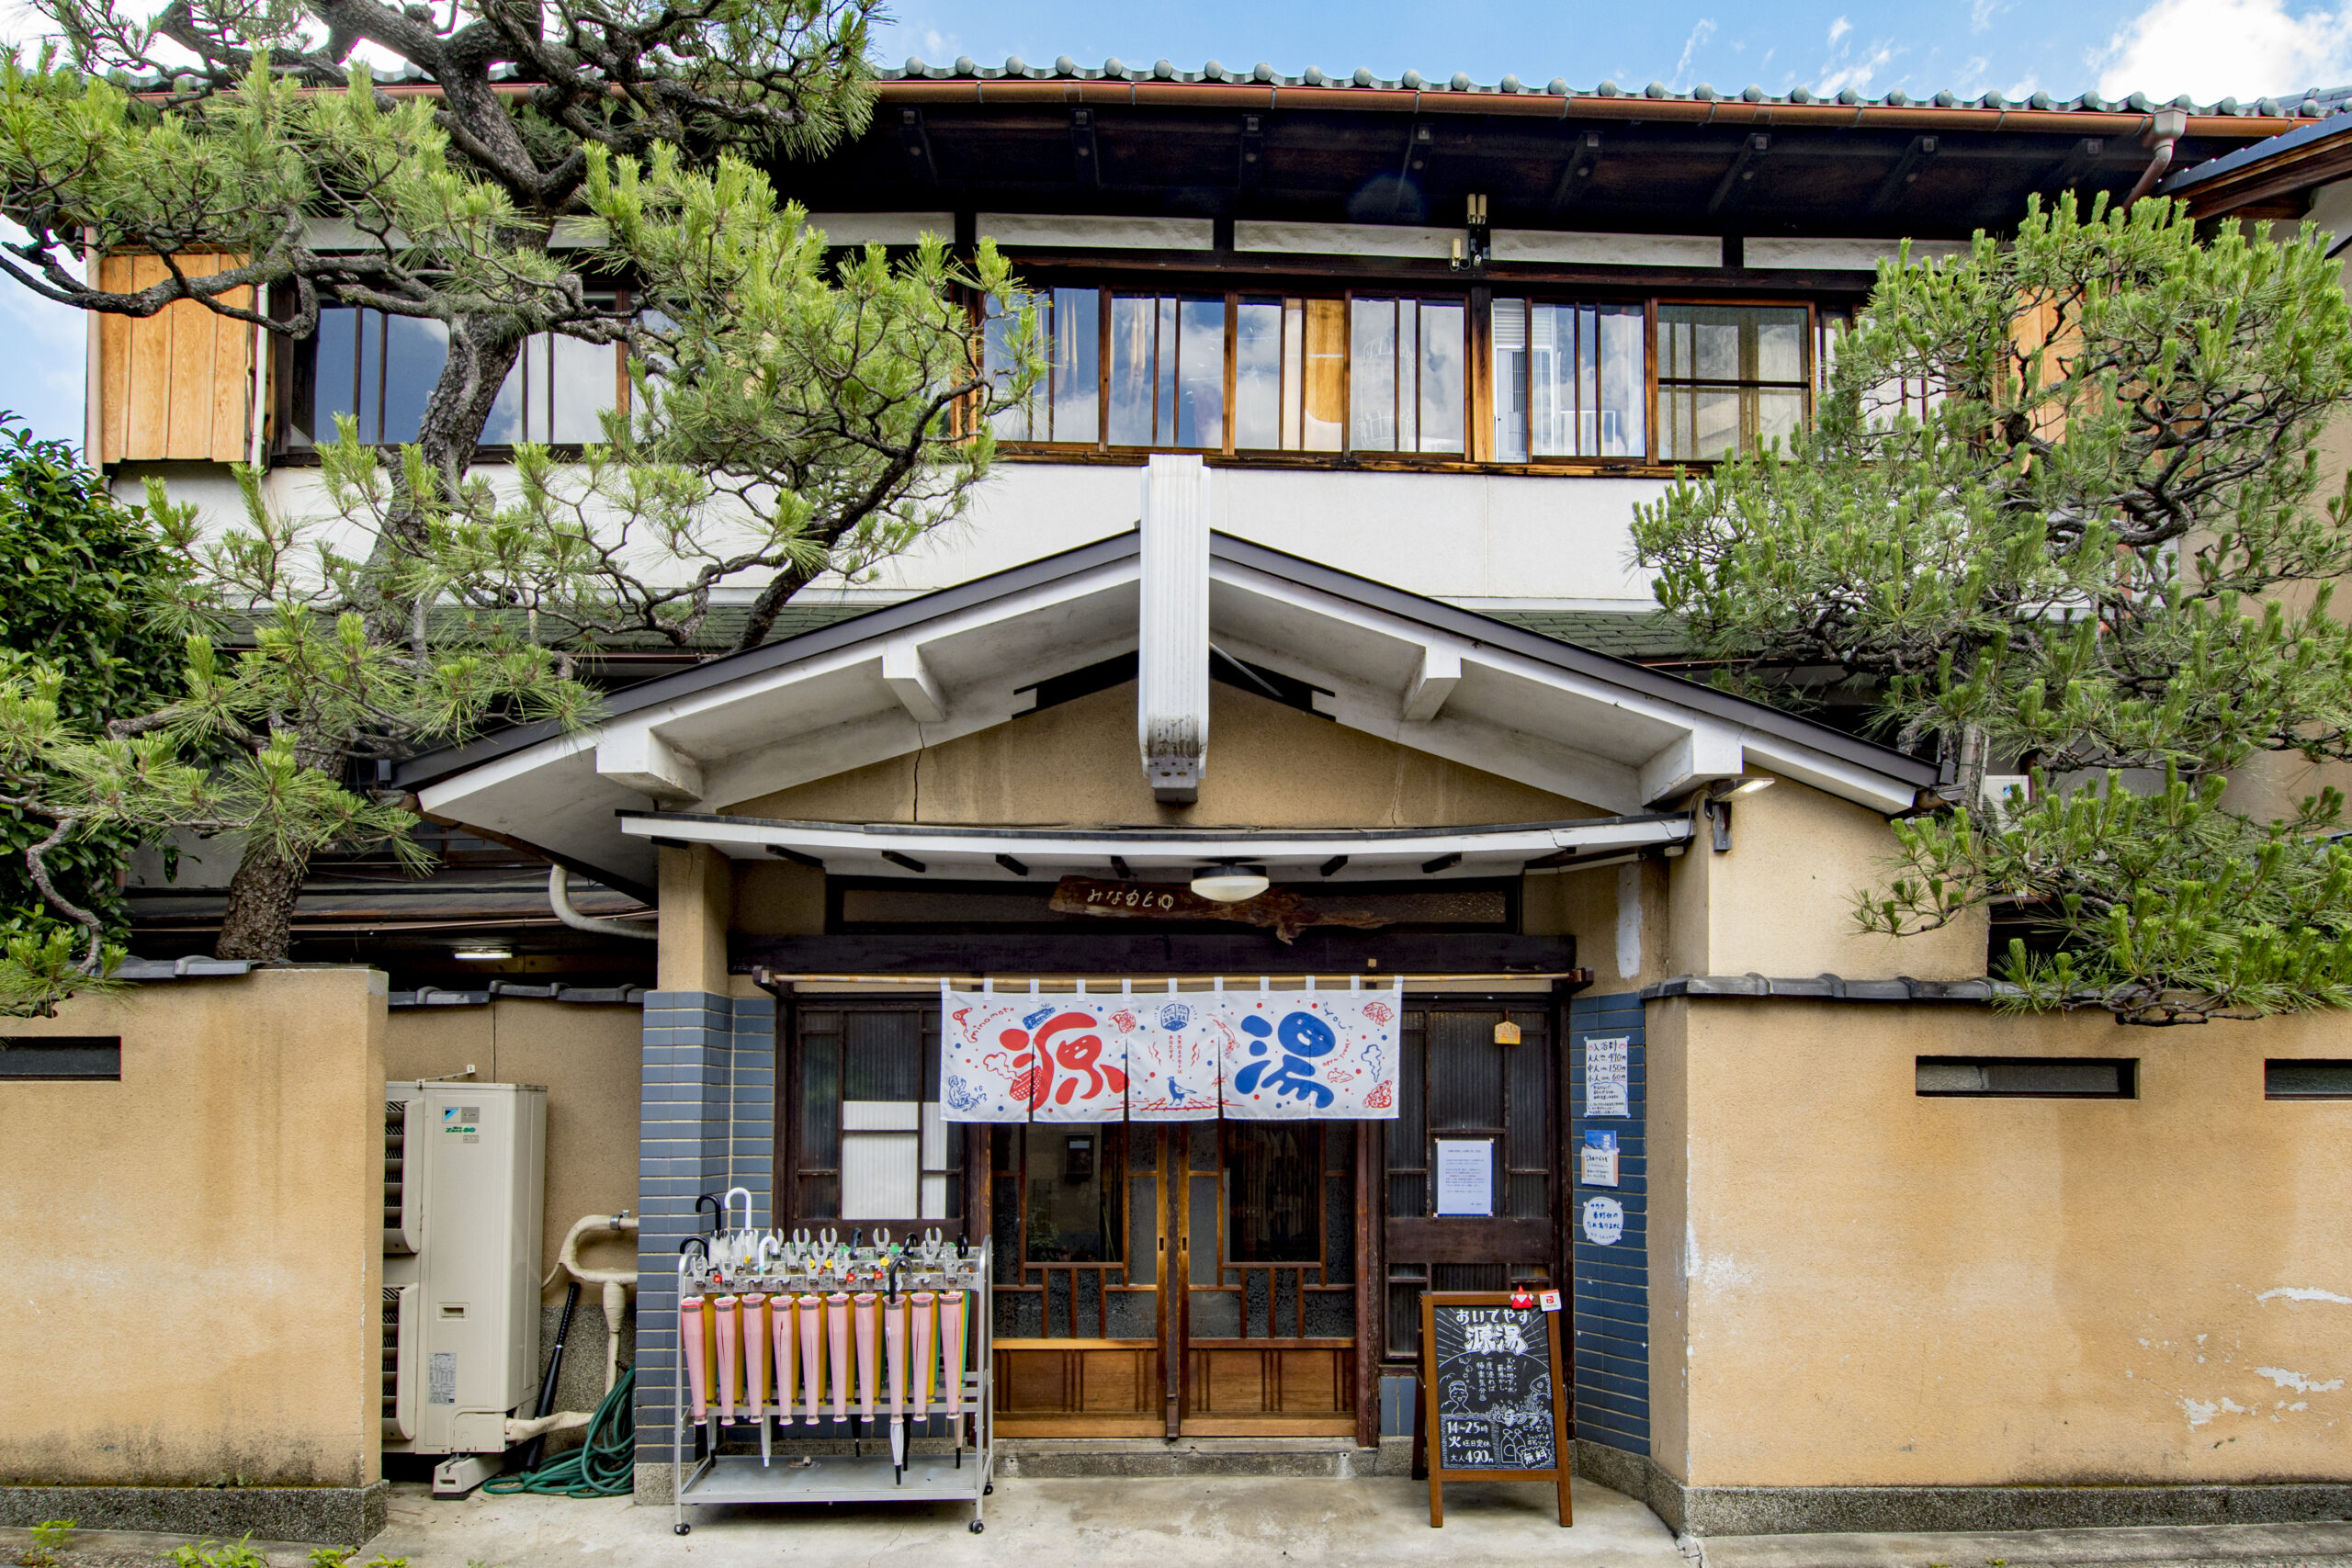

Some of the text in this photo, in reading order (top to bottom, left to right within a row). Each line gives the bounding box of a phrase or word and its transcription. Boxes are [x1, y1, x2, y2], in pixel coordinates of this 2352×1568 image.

[1456, 1309, 1530, 1325] おいでやす
[1464, 1323, 1529, 1356] 源湯
